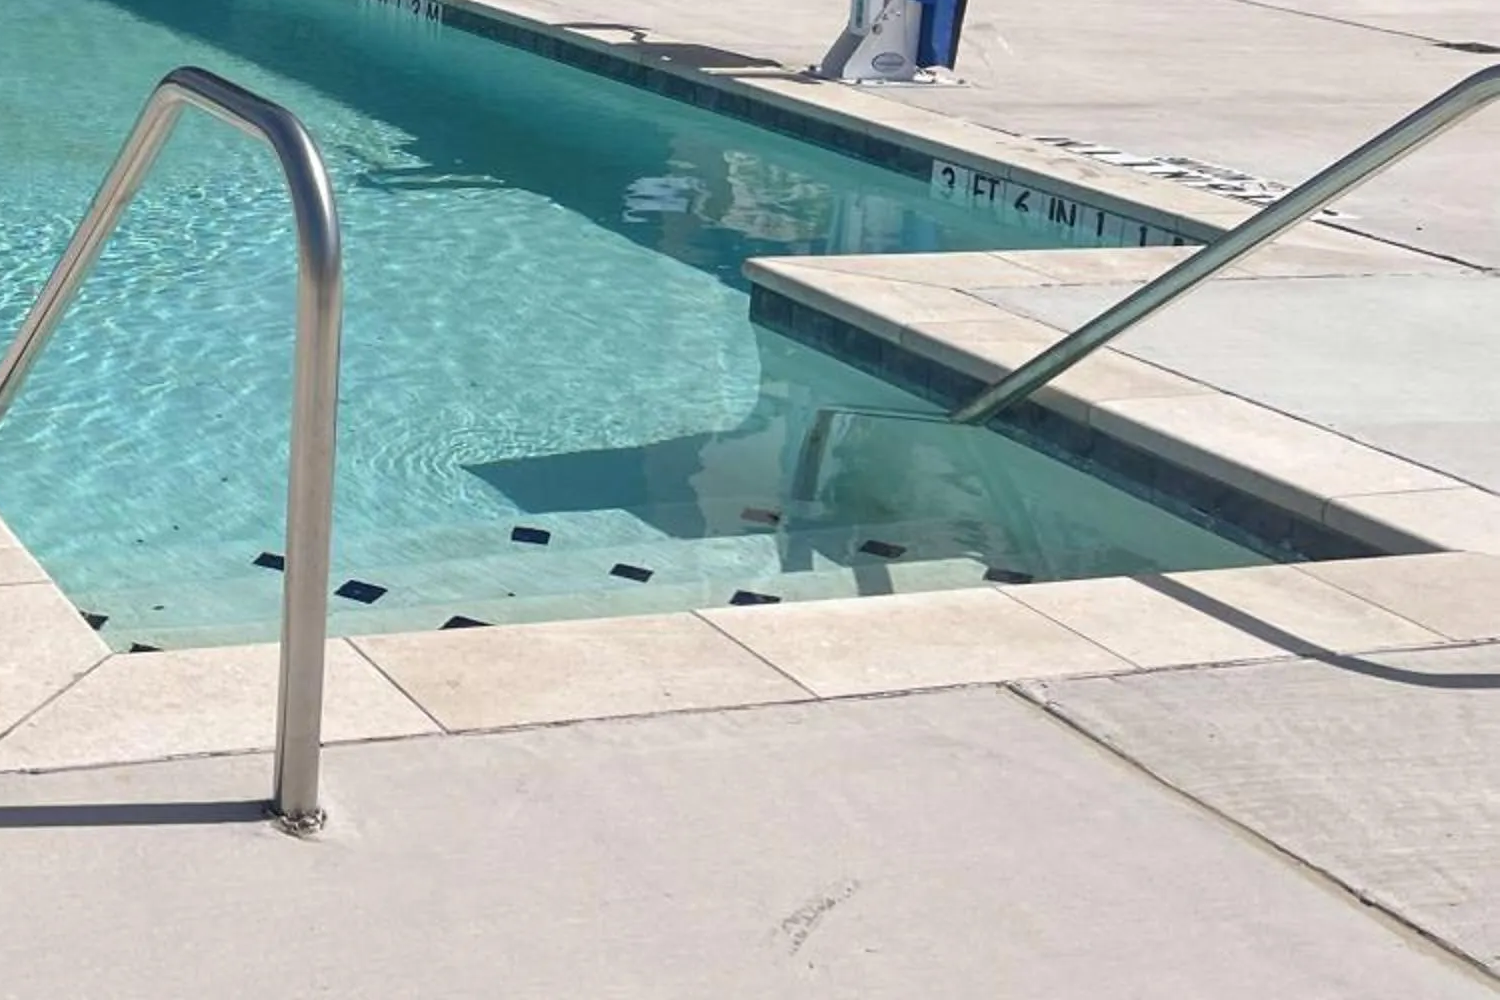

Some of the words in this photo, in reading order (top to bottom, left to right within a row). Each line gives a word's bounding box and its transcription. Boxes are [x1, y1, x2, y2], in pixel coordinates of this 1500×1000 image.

[972, 174, 1000, 201] FT
[1013, 190, 1031, 213] 6
[1049, 197, 1077, 228] IN
